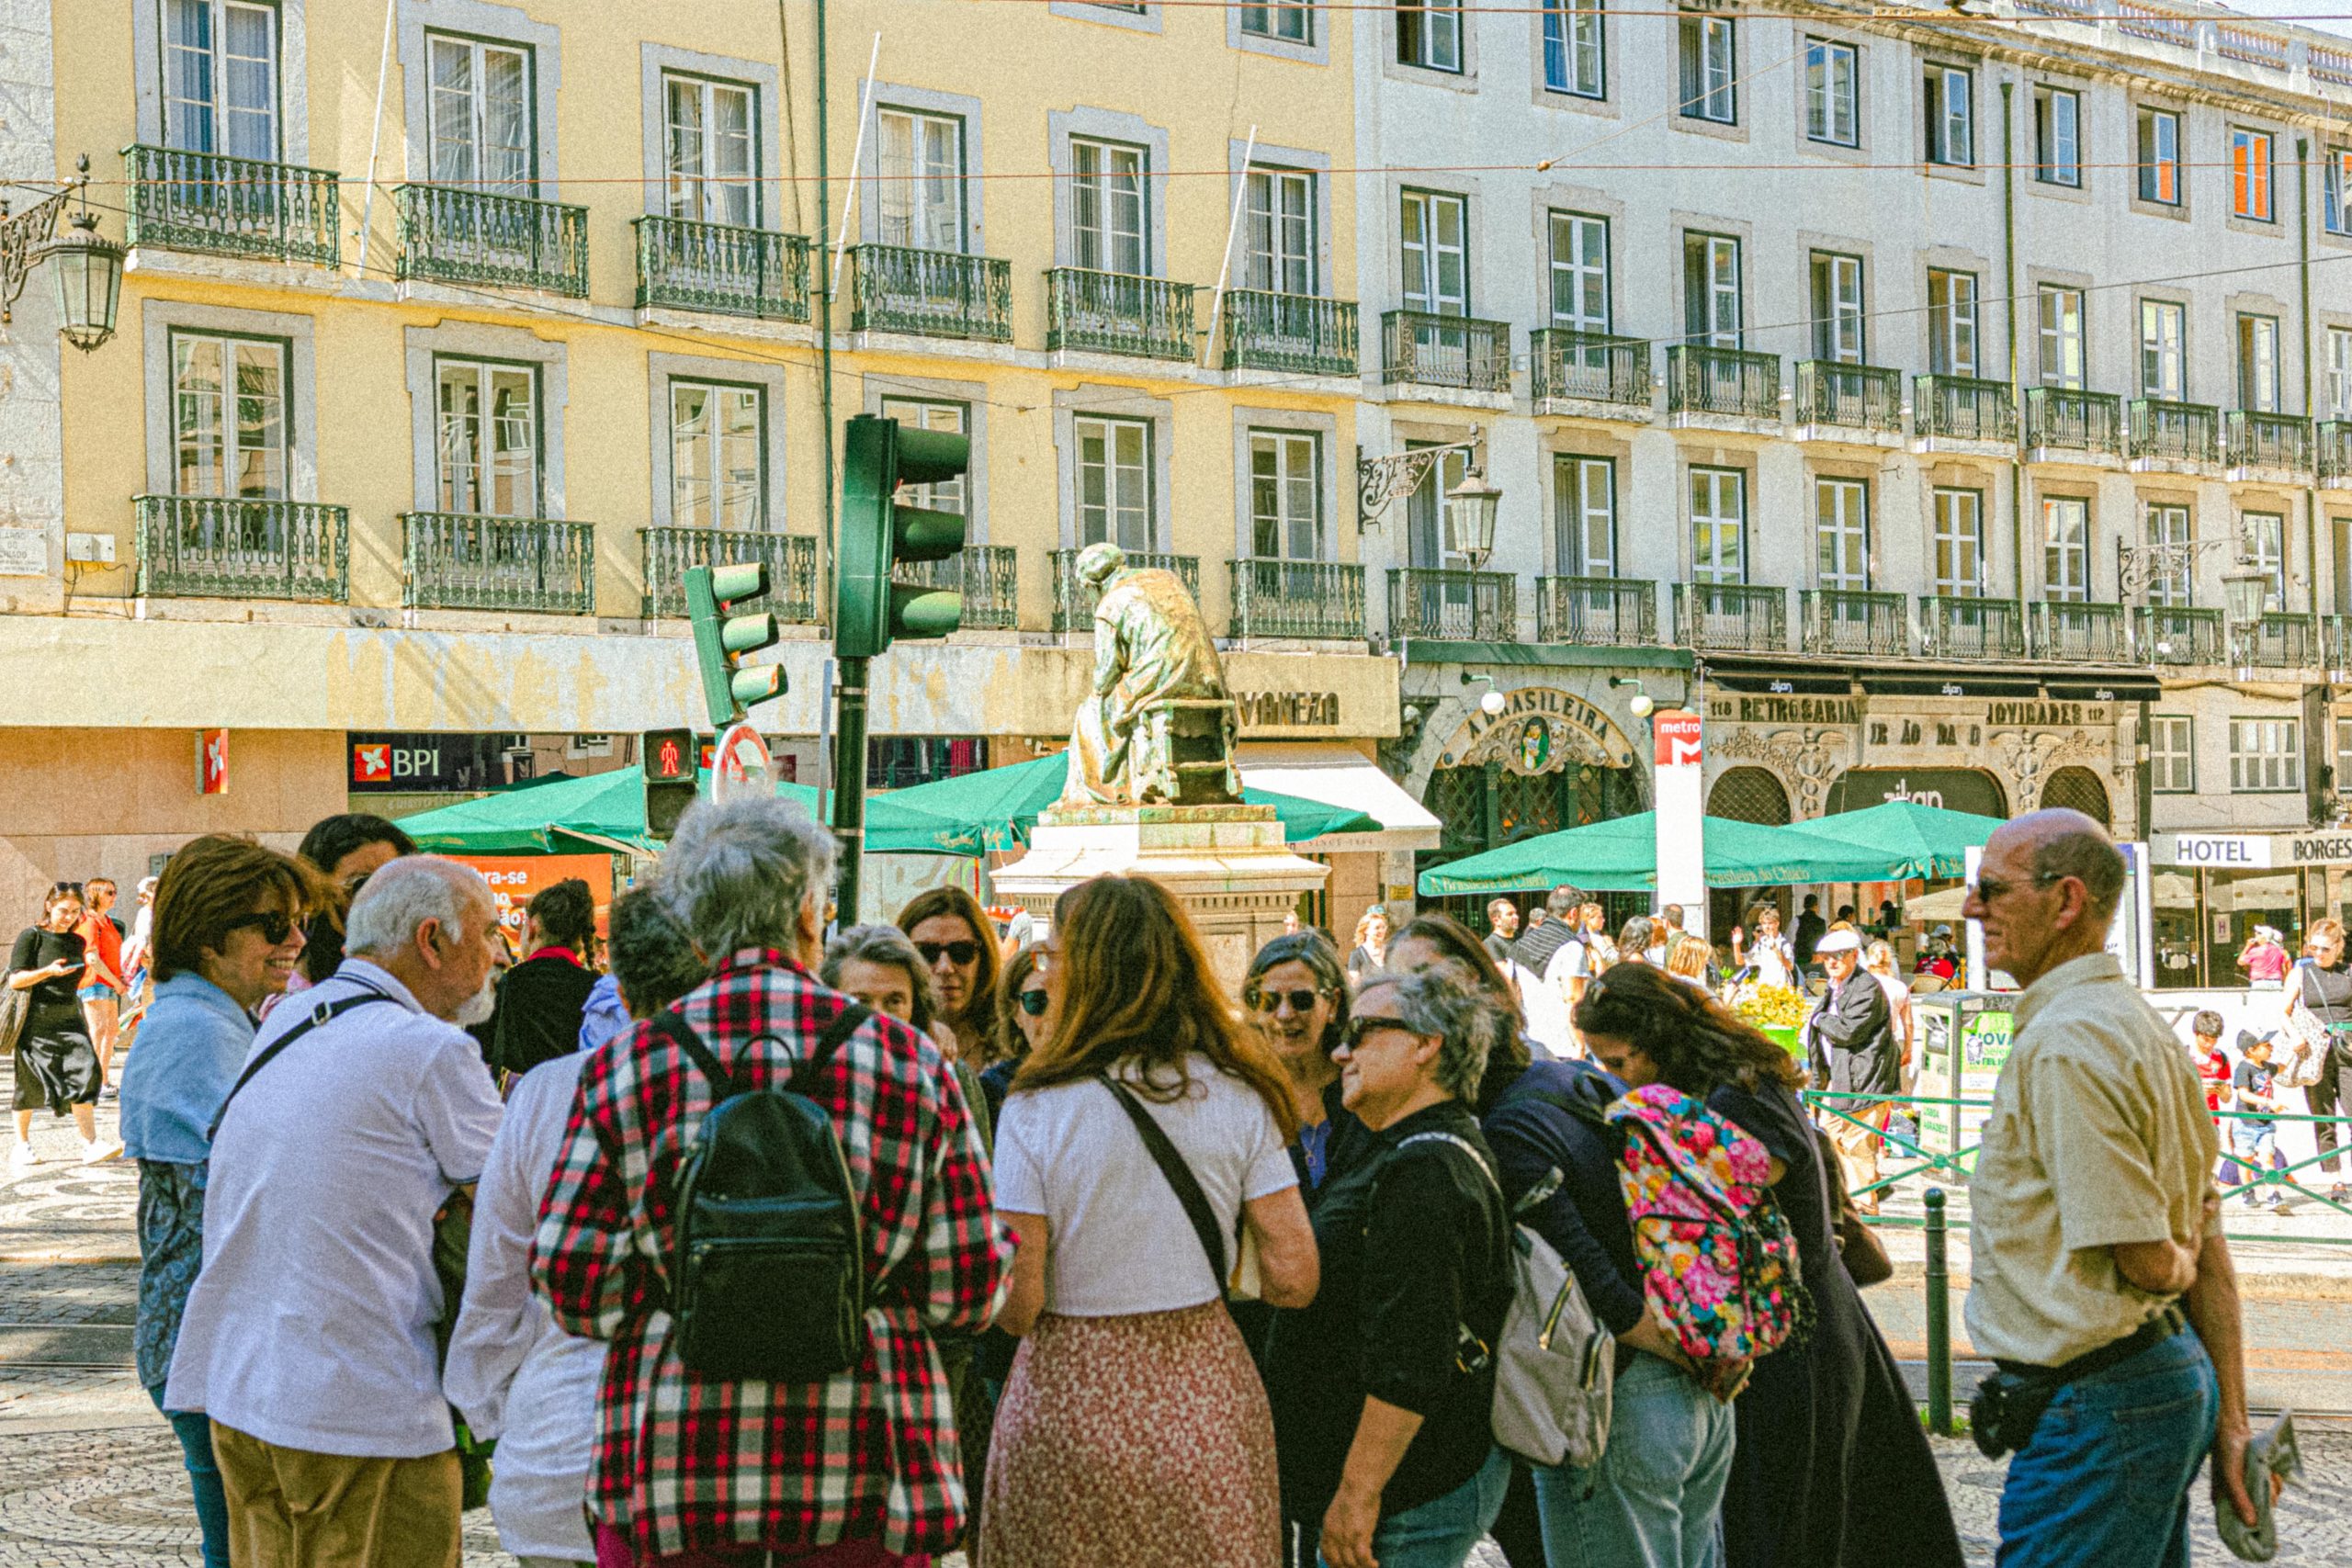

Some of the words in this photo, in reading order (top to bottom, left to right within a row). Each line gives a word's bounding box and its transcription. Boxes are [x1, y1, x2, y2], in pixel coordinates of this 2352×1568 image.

[1231, 692, 1339, 726] VANEZA
[1711, 701, 1732, 716] 118
[1739, 697, 1859, 724] RETROSARIA
[1660, 720, 1702, 734] metro
[392, 749, 439, 777] BPI
[2177, 840, 2252, 862] HOTEL
[2293, 838, 2352, 862] BORGES
[1705, 869, 1758, 885] rasileira
